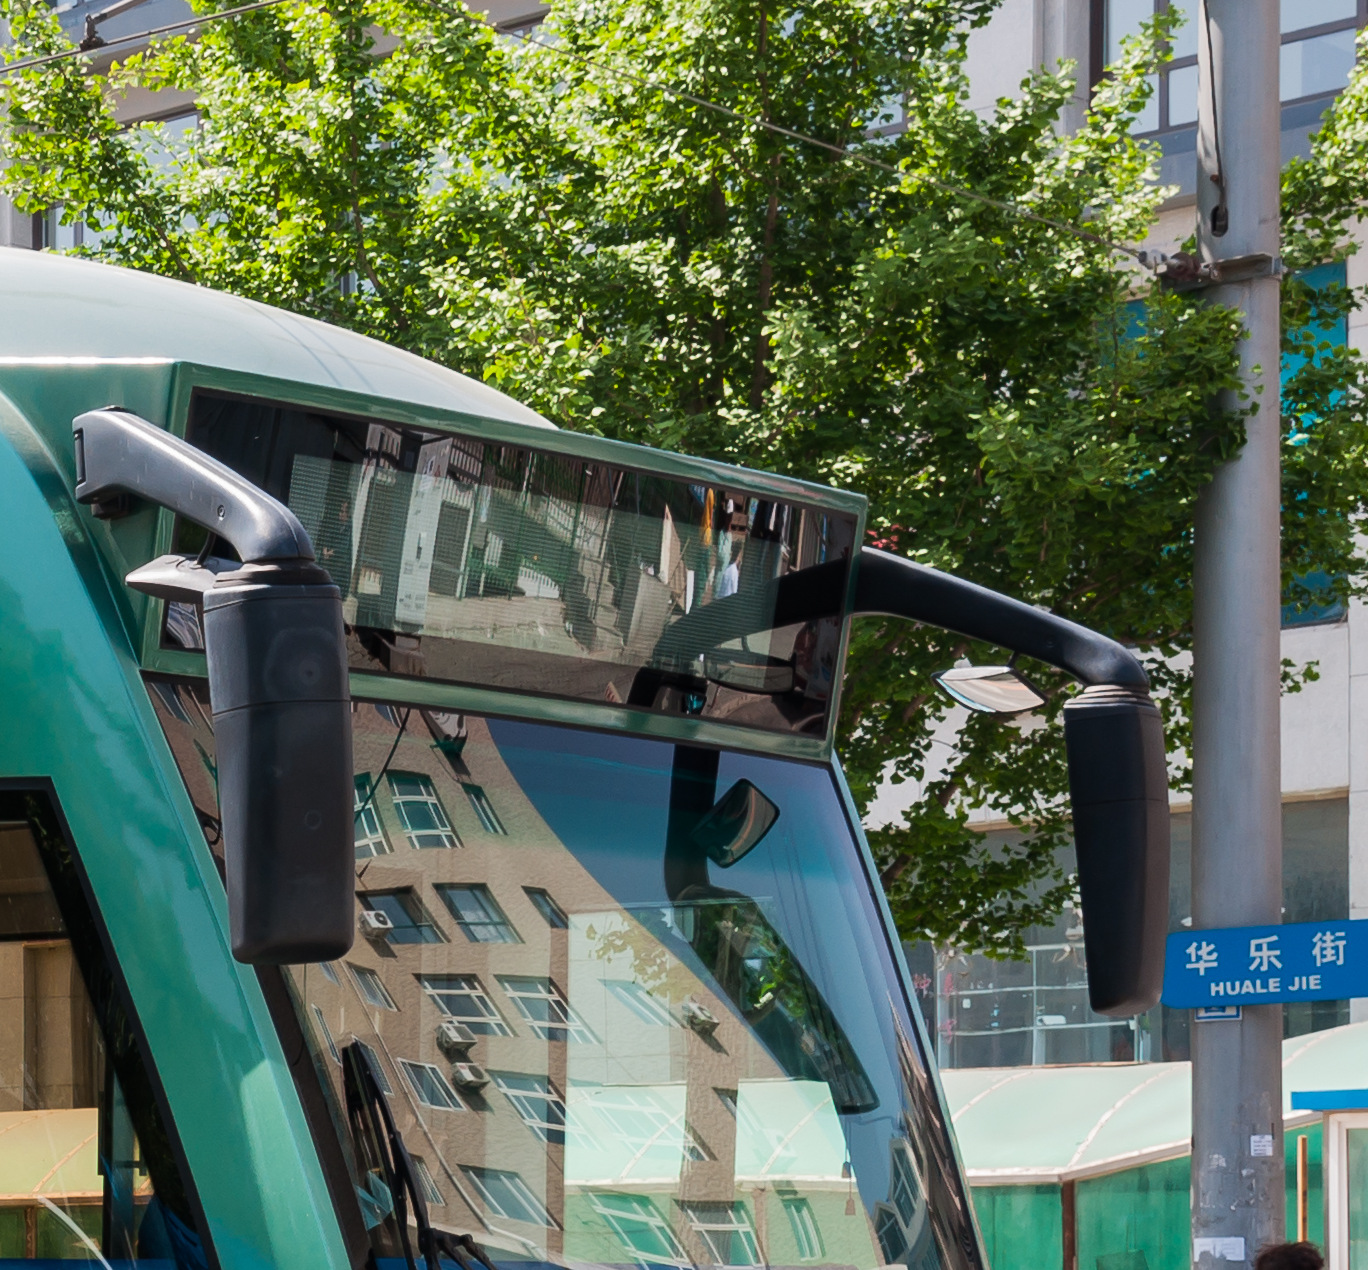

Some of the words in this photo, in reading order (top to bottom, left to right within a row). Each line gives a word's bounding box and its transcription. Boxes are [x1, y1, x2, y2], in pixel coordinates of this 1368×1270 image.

[1185, 930, 1347, 976] 华乐街
[1210, 977, 1281, 997] HUALE
[1288, 974, 1322, 992] JIE
